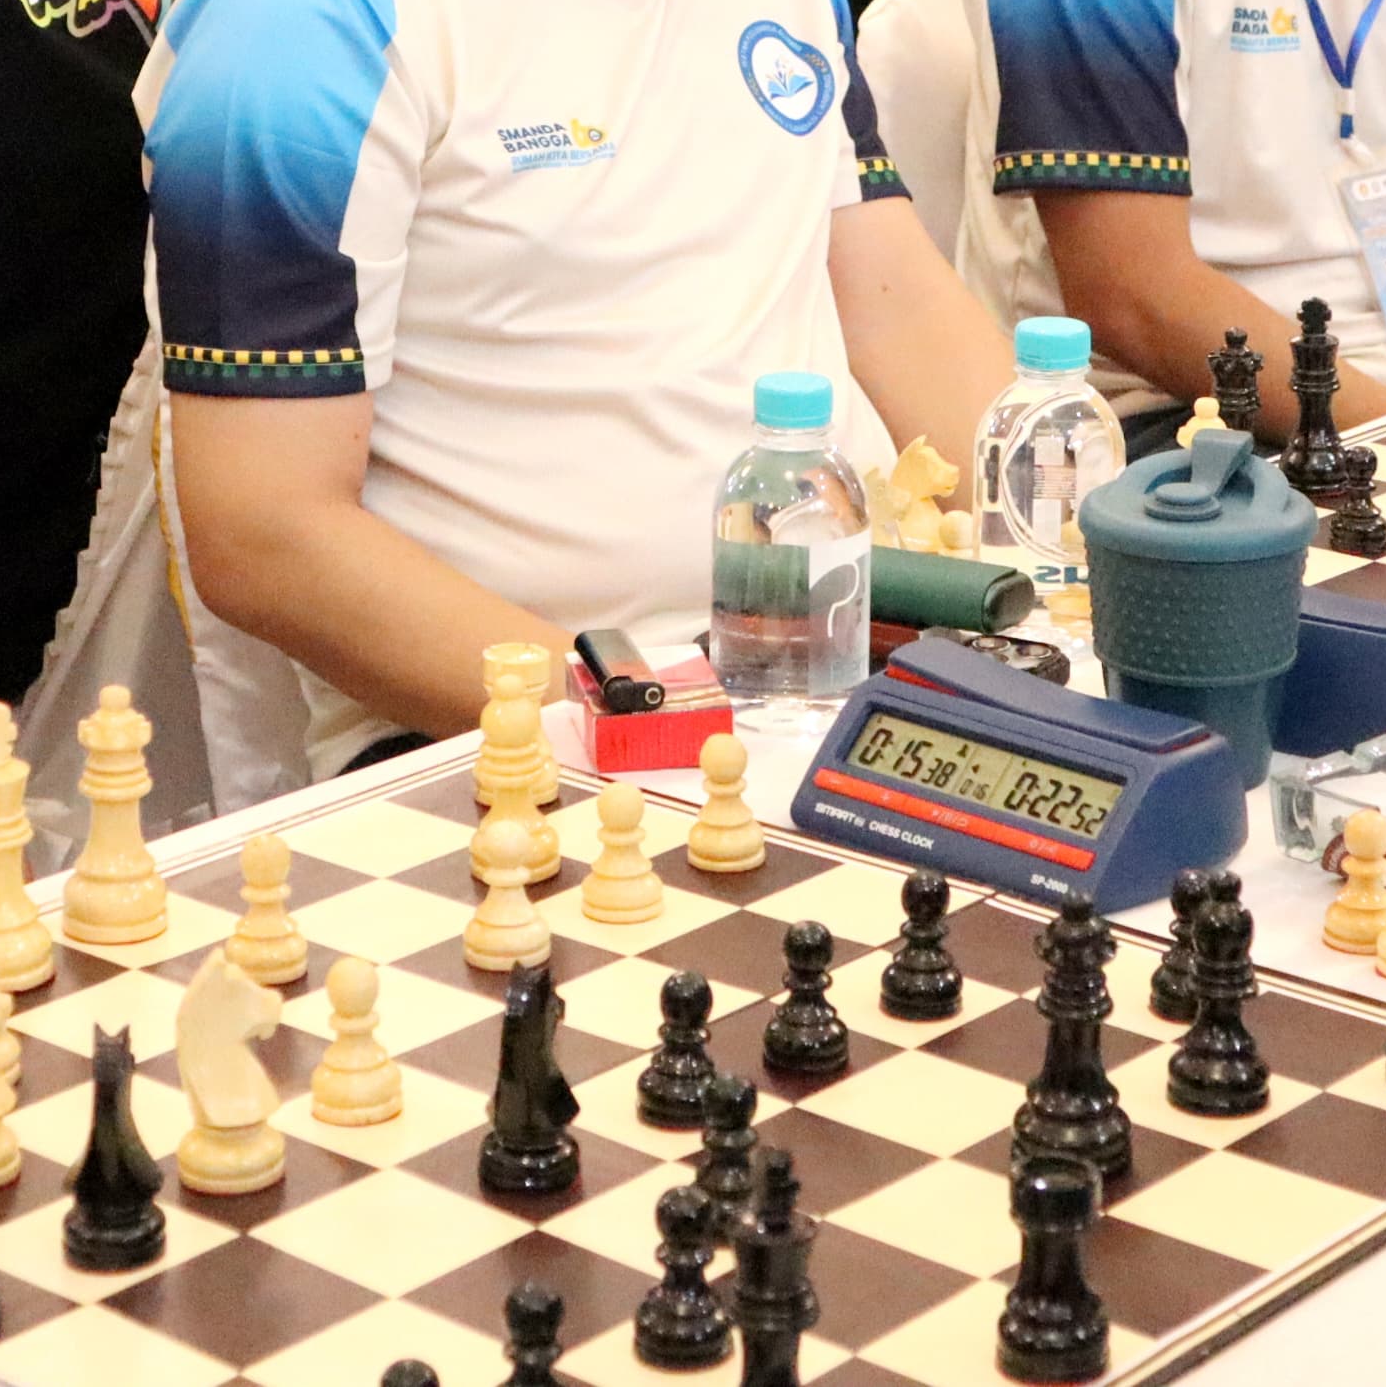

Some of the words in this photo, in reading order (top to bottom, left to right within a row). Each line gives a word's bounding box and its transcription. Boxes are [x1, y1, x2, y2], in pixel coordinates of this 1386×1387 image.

[497, 123, 567, 142] SMANDA
[503, 134, 573, 153] BANGGA
[868, 820, 901, 839] CHESS
[900, 830, 935, 851] CLOCK
